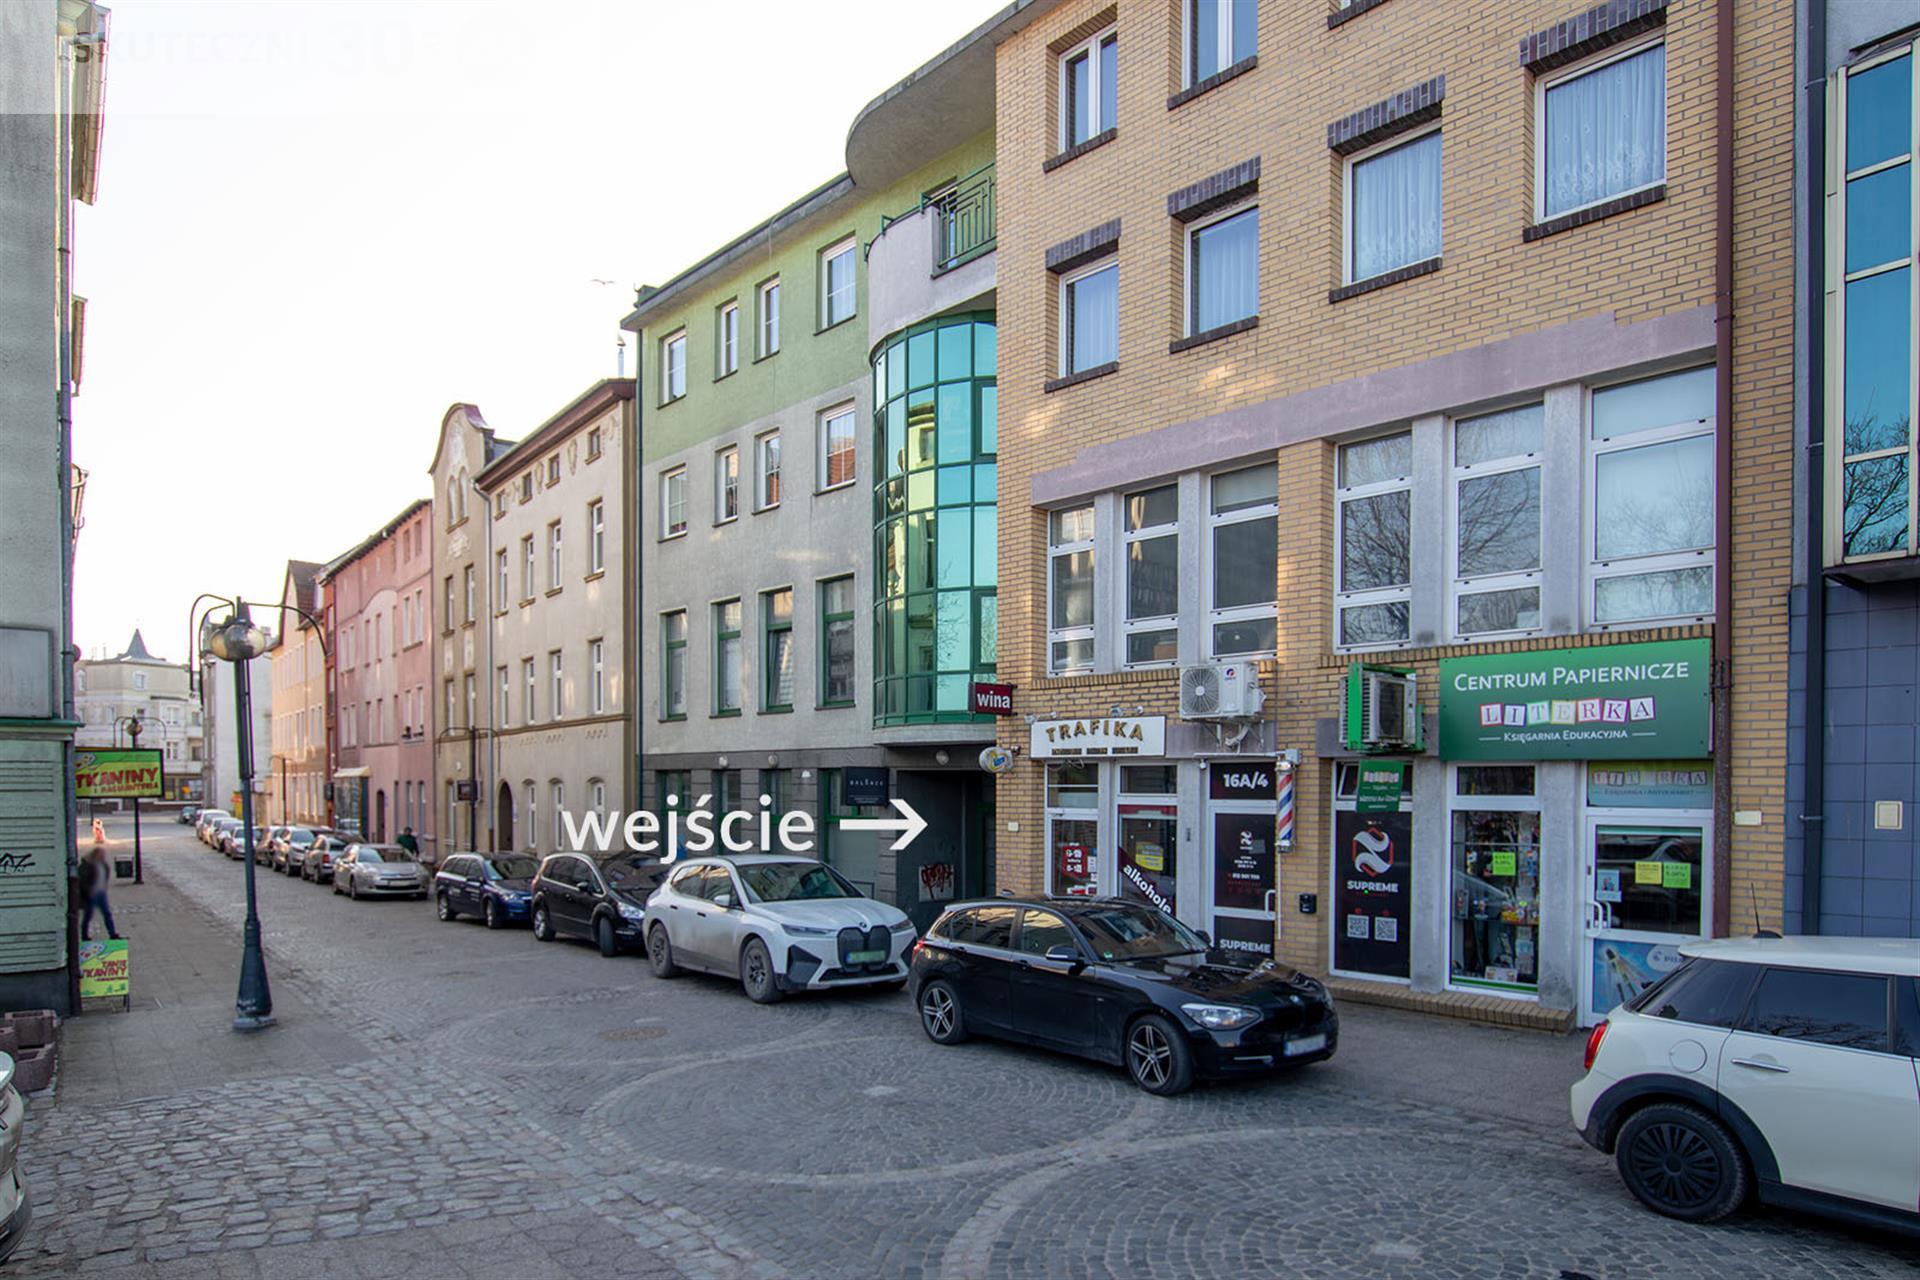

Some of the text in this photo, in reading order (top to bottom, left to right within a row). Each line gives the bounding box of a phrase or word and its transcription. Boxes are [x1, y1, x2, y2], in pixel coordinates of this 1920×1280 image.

[1454, 662, 1689, 691] CENTRUM PAPIERNICZE
[977, 690, 1010, 709] wina
[1481, 698, 1654, 725] LITERKA
[1046, 720, 1143, 742] TRAFIKA
[76, 767, 158, 788] TKANINY
[1223, 772, 1269, 789] 16A/4
[1123, 864, 1172, 914] alkohole
[1347, 880, 1399, 893] SUPREME
[1219, 938, 1271, 953] SUPREME
